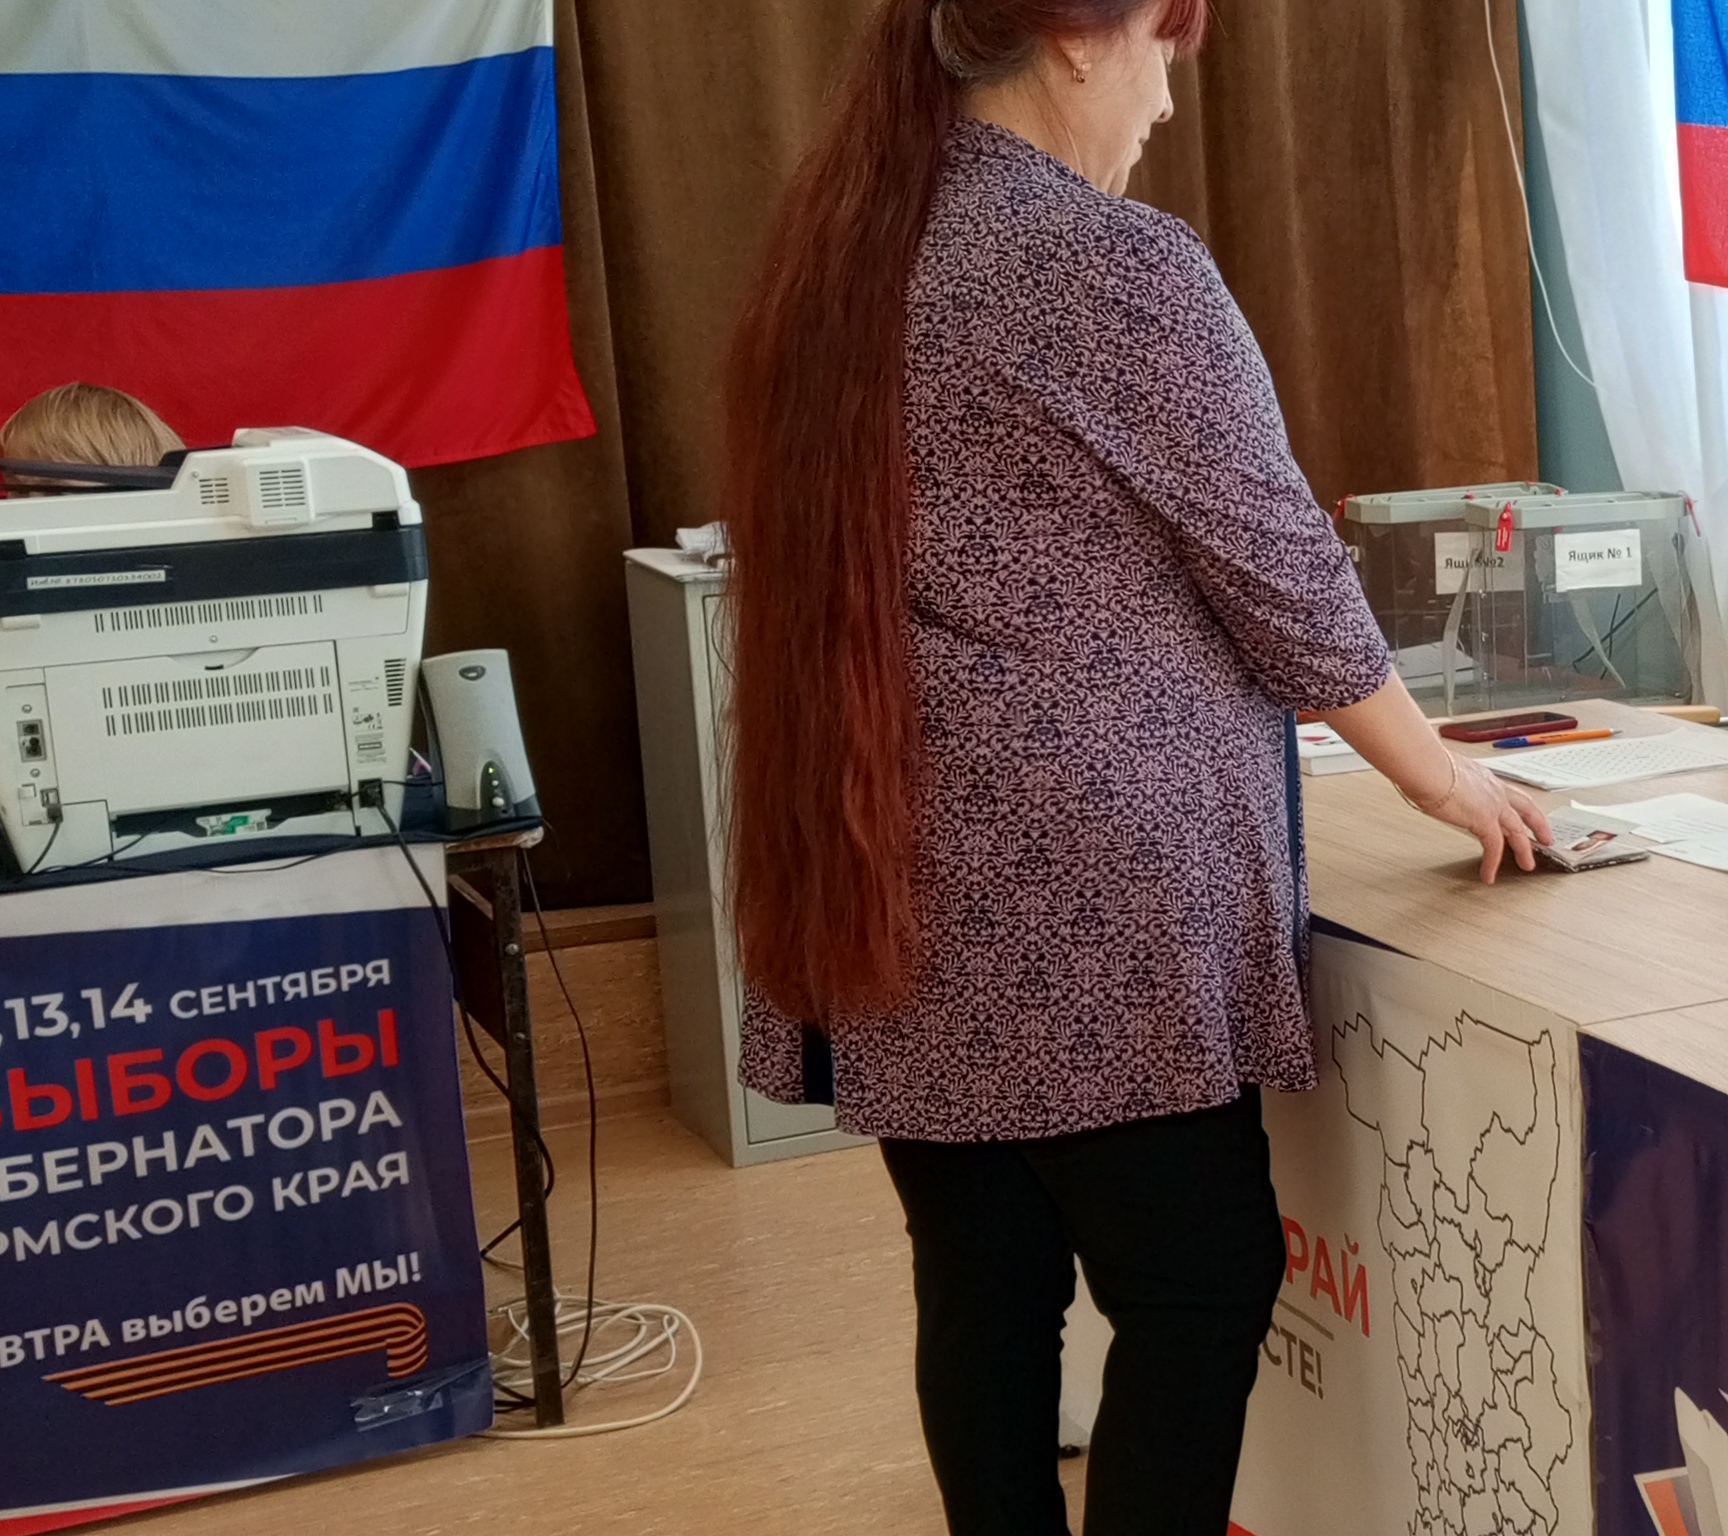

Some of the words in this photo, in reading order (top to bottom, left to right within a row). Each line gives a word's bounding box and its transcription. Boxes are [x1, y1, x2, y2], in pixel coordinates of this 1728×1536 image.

[1568, 549, 1604, 565] Ящик
[1607, 547, 1622, 560] №
[1625, 546, 1633, 558] 1
[169, 959, 392, 1020] СЕНТЯБРЯ
[0, 1008, 401, 1132] ЫБОРЫ
[272, 1151, 410, 1214] КРАЯ
[121, 1280, 325, 1343] выберем
[336, 1252, 422, 1302] МЫ!
